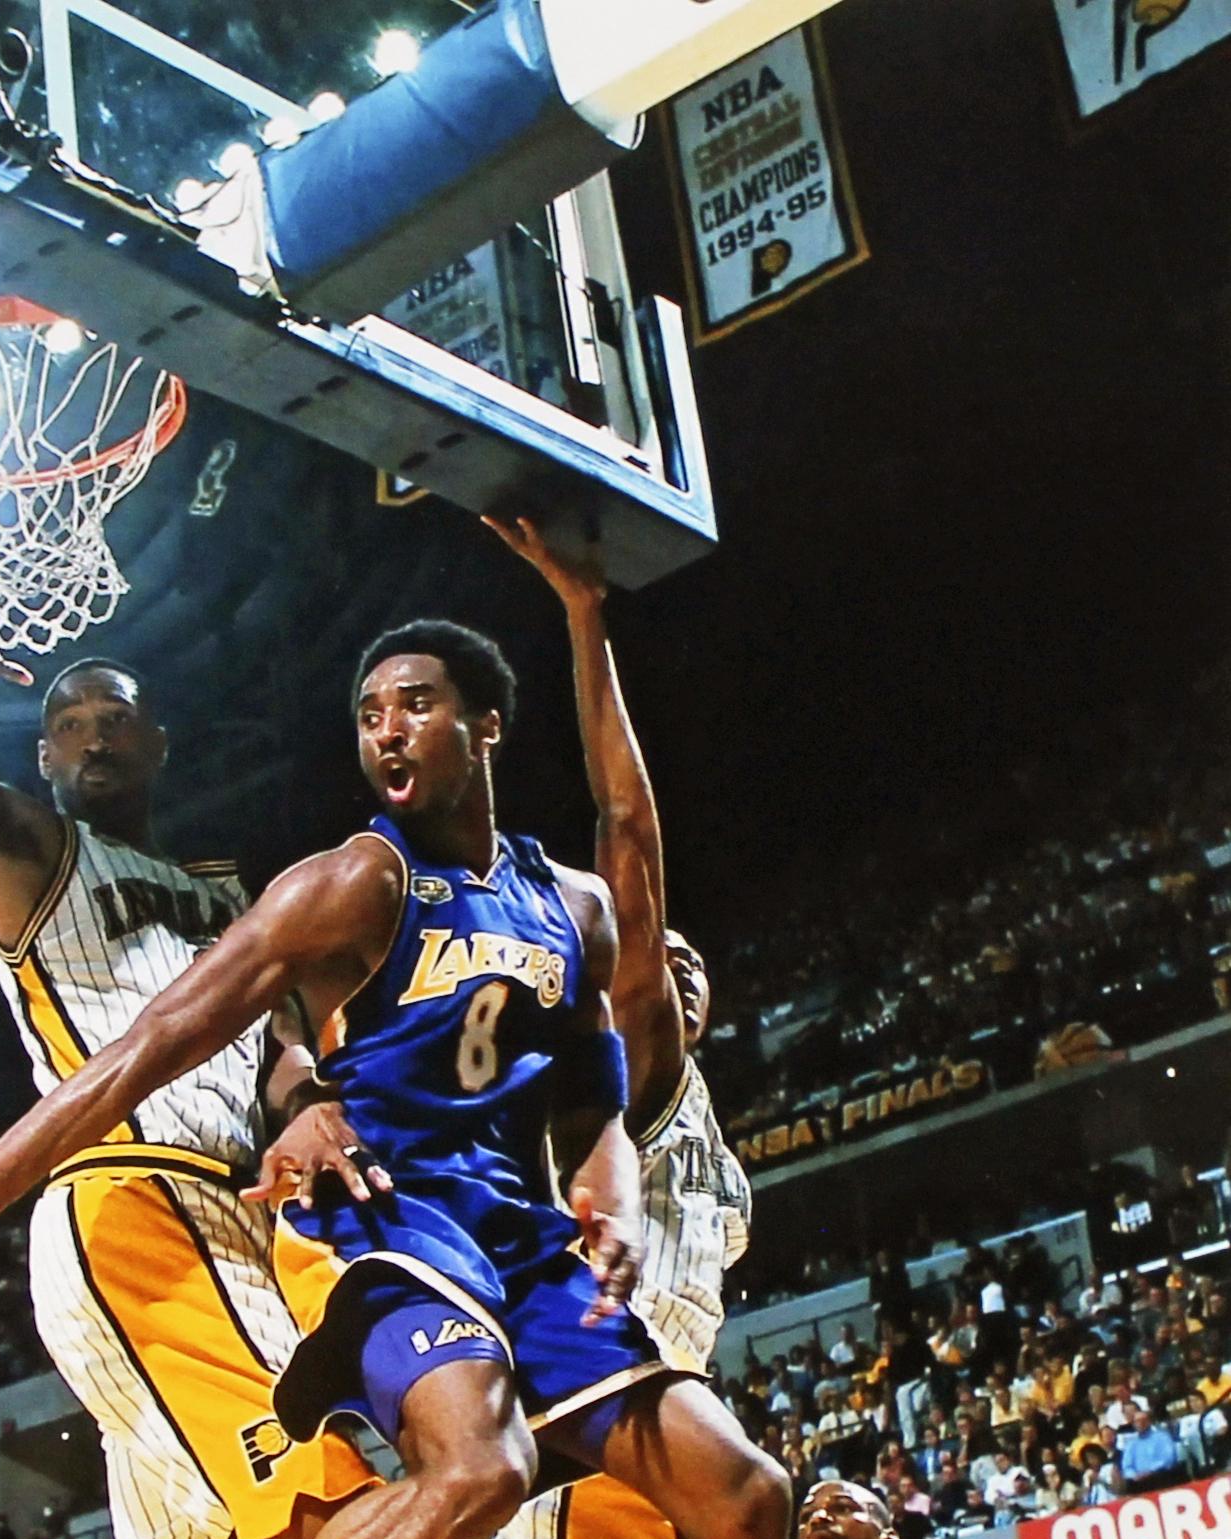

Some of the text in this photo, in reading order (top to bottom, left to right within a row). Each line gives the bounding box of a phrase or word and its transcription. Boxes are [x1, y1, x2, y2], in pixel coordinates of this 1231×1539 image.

[701, 65, 784, 133] NBA
[698, 140, 822, 234] CHAMPIONS
[704, 181, 827, 267] 1994-95
[397, 929, 566, 1008] LAKERS
[456, 980, 508, 1093] 8
[842, 1060, 982, 1131] FINALS
[433, 1318, 497, 1347] LAKE
